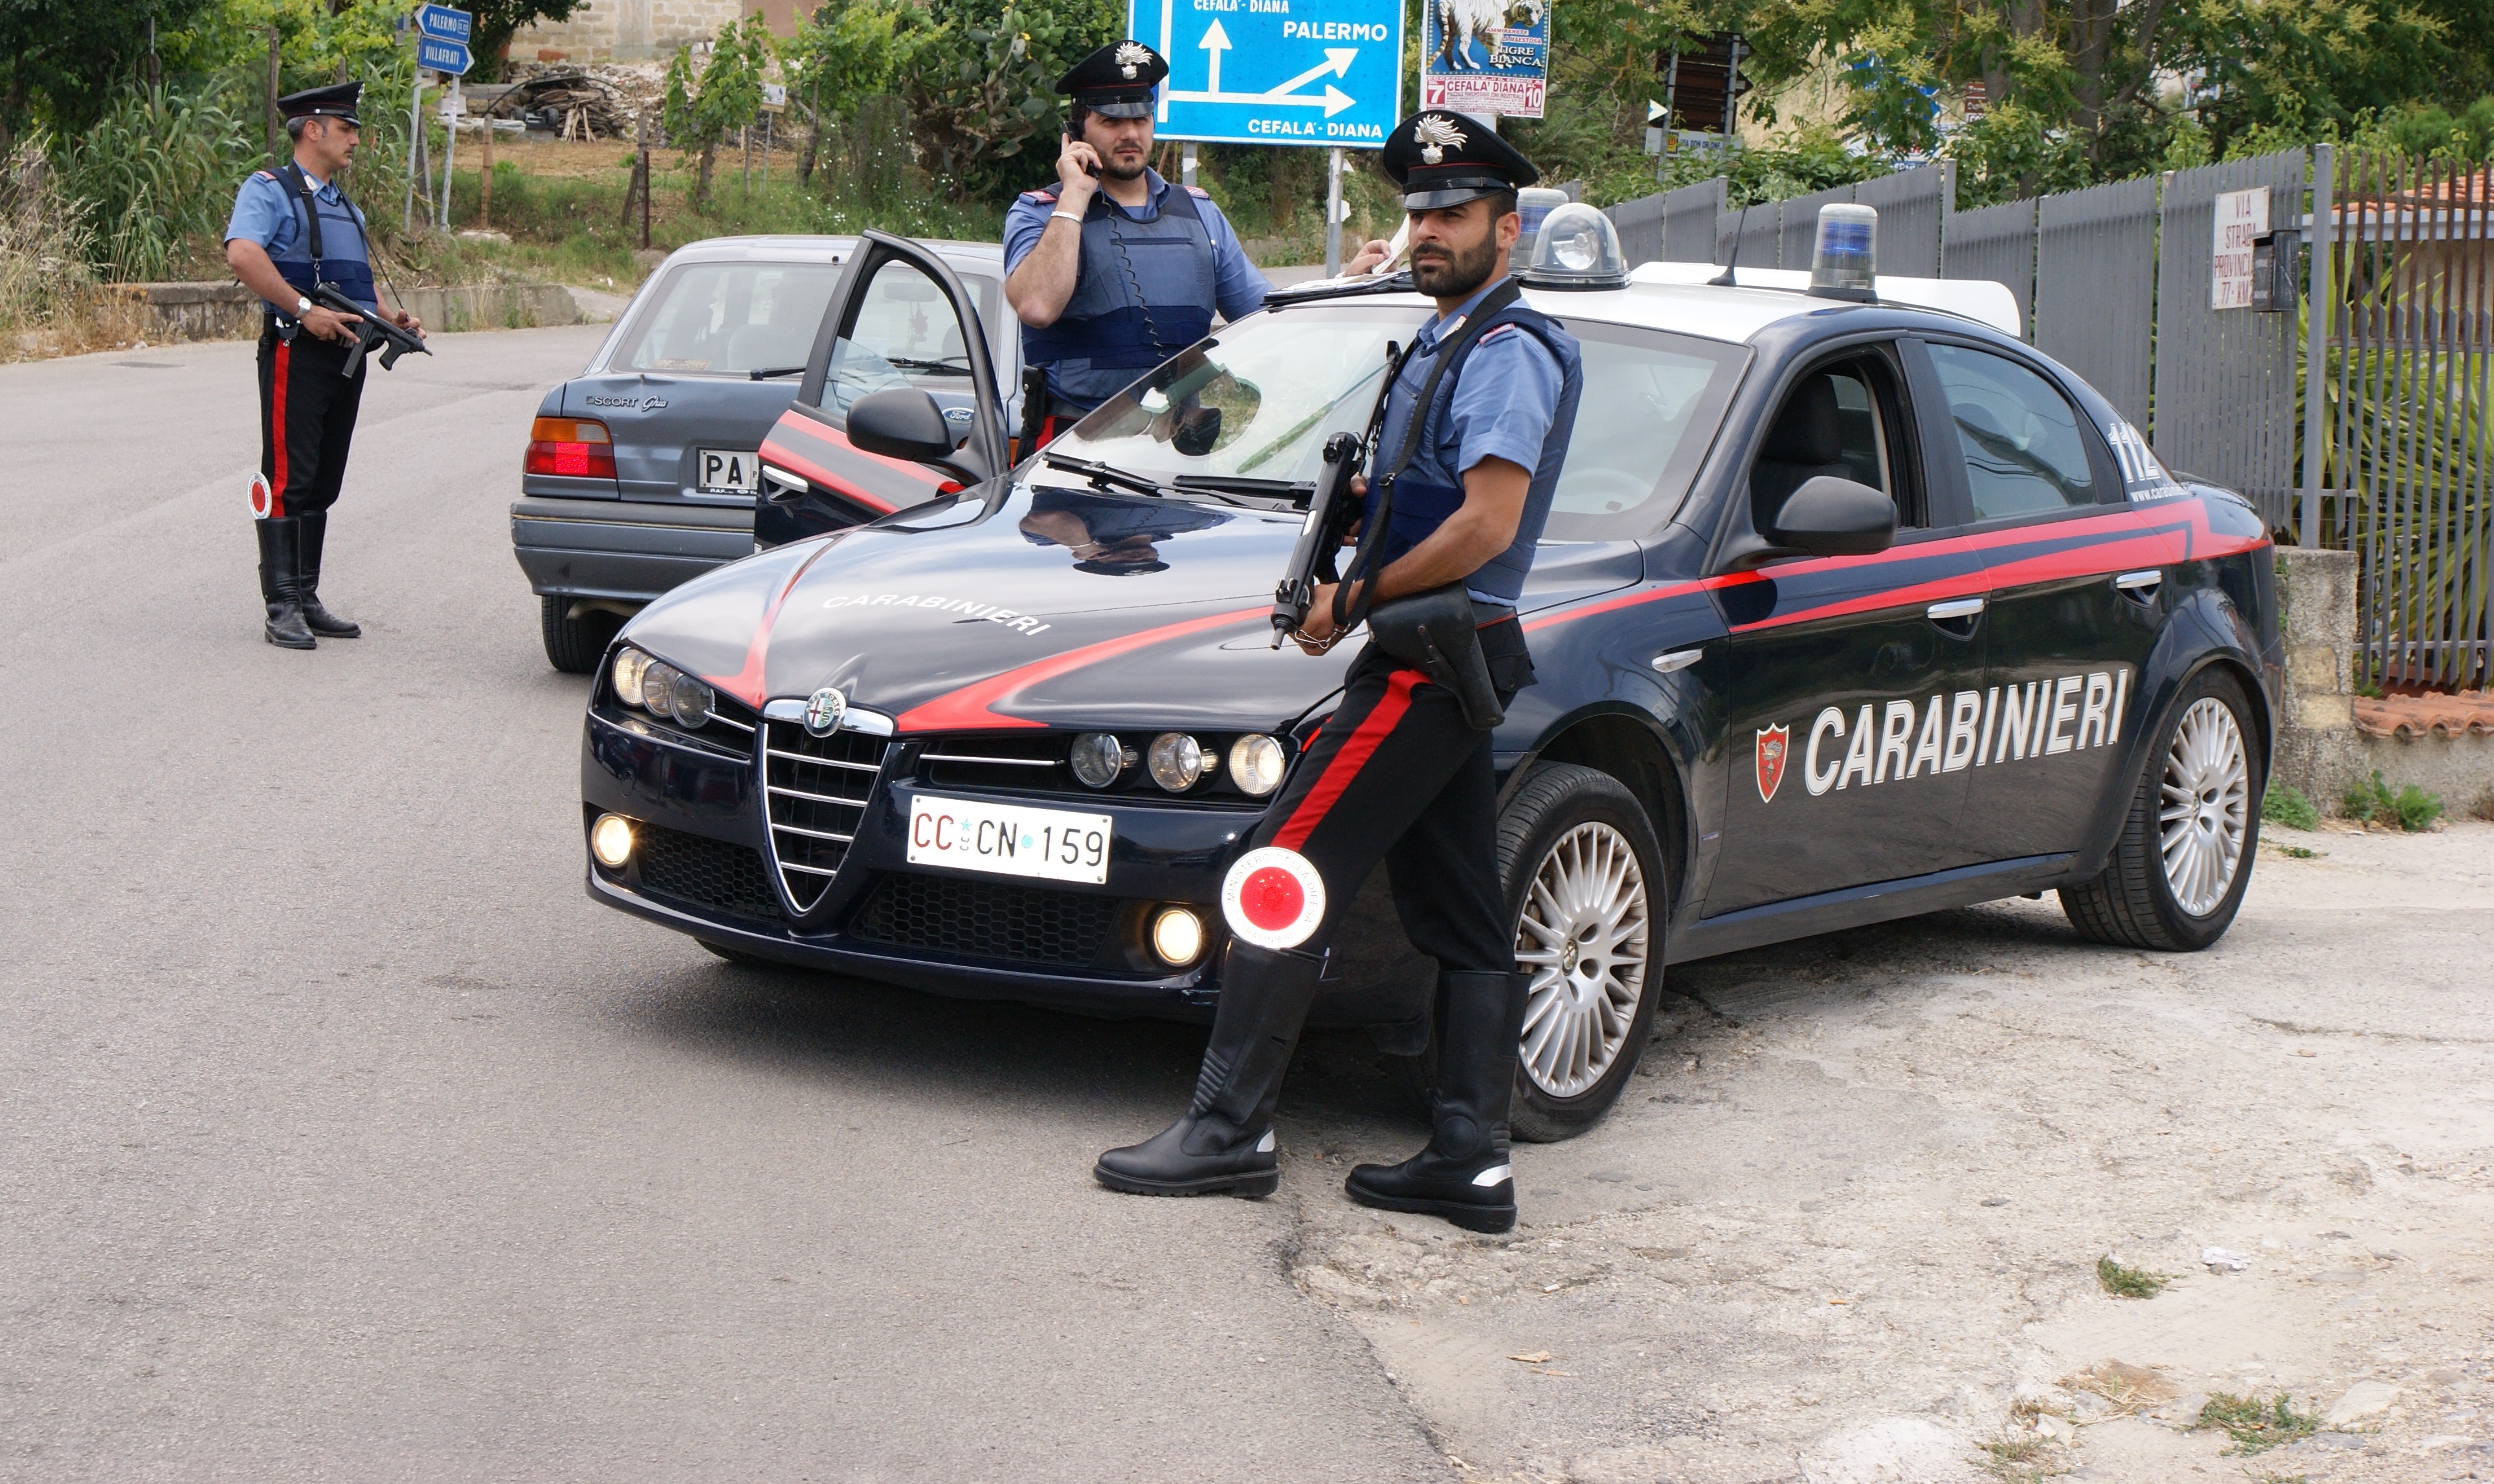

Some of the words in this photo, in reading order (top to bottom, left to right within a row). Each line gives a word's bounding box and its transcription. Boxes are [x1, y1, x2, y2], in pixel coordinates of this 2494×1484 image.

[1249, 0, 1290, 14] DIANA
[429, 12, 457, 32] PALERMO
[1283, 21, 1388, 41] PALERMO
[425, 45, 460, 65] VILLAFRATI
[1499, 45, 1535, 56] TIGRE
[1489, 55, 1542, 67] BIANCA
[1428, 85, 1444, 104] 7
[1493, 82, 1524, 94] DIANA
[1526, 88, 1542, 107] 10
[1326, 122, 1383, 138] DIANA
[2236, 194, 2251, 219] VIA
[641, 395, 669, 412] Ghia
[950, 410, 971, 420] Ford
[706, 454, 743, 485] PA
[822, 593, 1052, 636] CARABINIERI
[1804, 669, 2128, 797] CARABINIERI
[913, 813, 954, 850] CC
[977, 819, 1018, 858] CN
[1043, 826, 1104, 867] 159
[1227, 854, 1270, 902] MINISTERO
[1304, 881, 1318, 923] DIFESA
